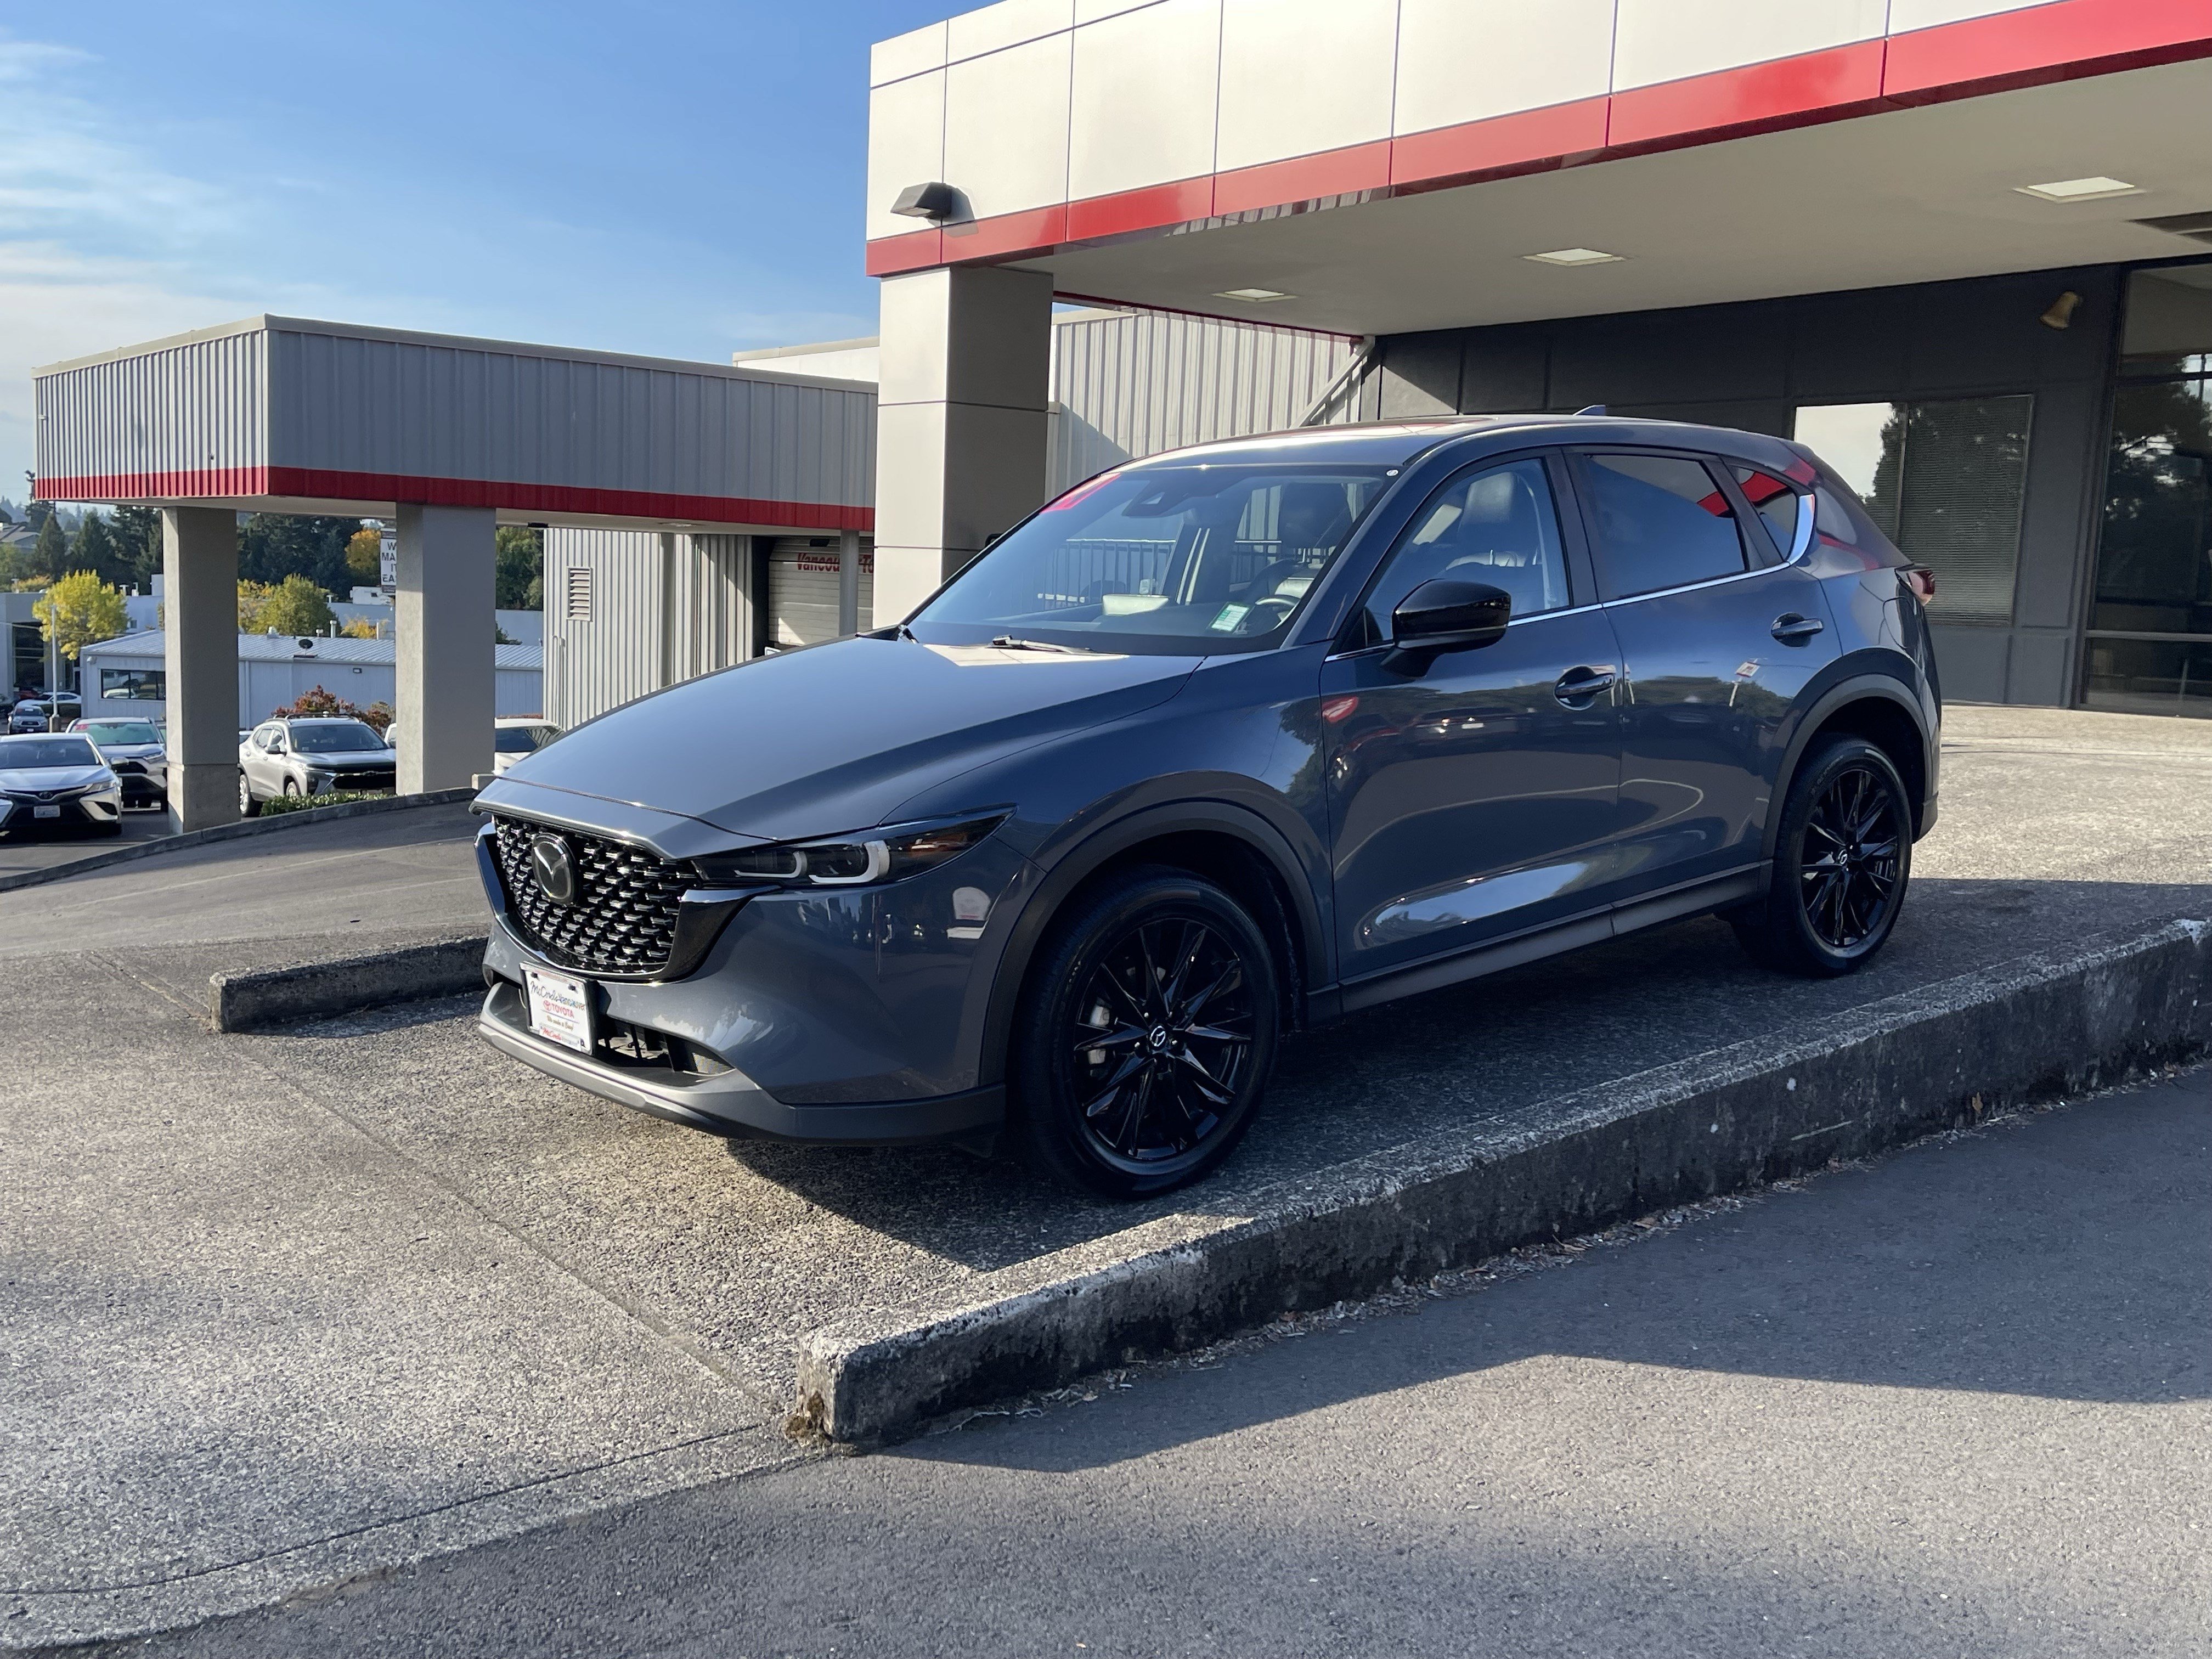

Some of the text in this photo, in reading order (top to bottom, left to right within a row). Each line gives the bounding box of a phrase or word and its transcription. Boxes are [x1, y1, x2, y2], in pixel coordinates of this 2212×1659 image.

[381, 552, 396, 562] MA
[797, 552, 840, 572] Vancou
[382, 574, 395, 583] EA
[551, 1003, 574, 1019] TOYOTA
